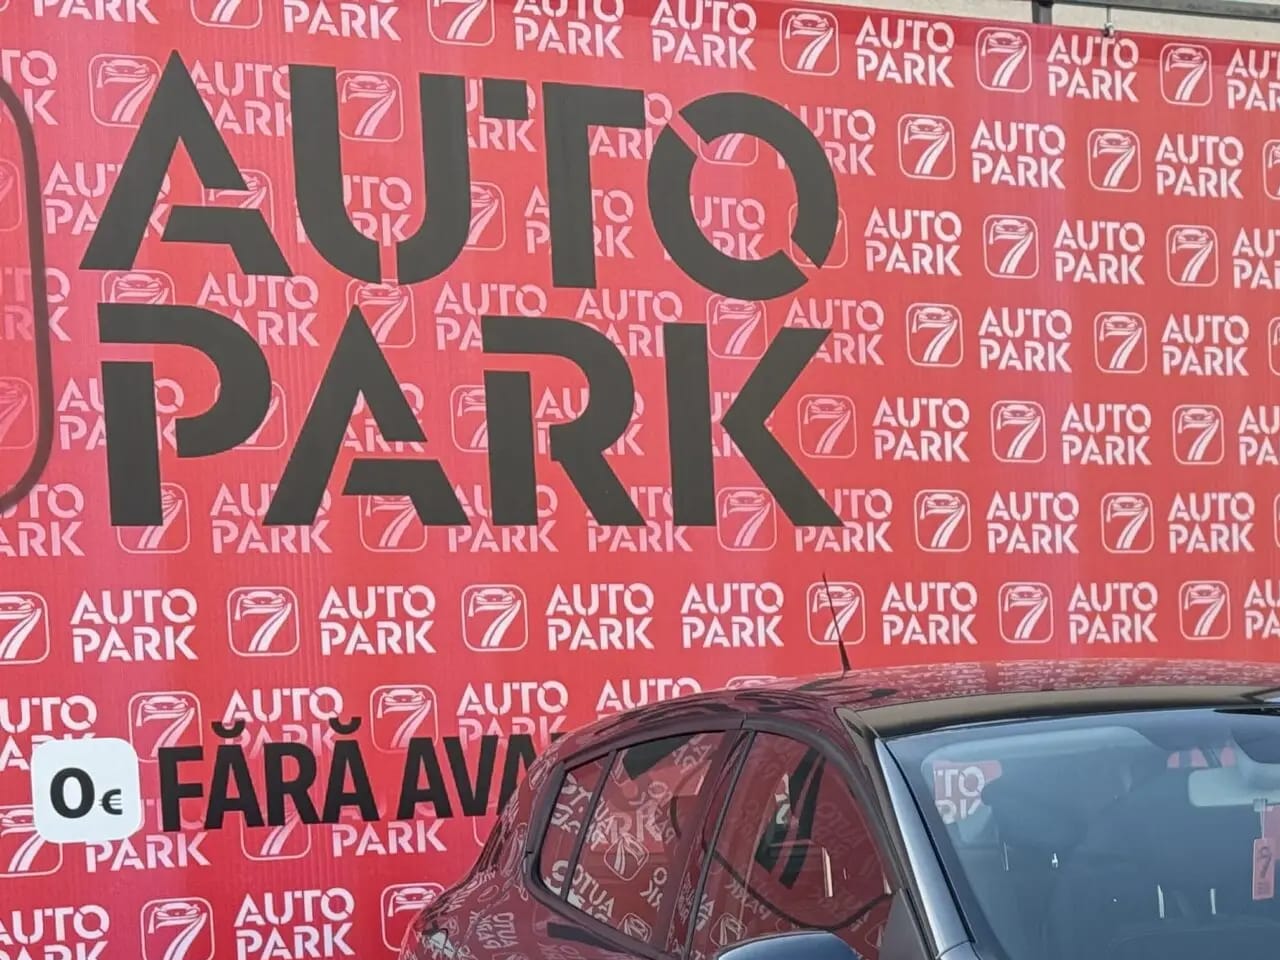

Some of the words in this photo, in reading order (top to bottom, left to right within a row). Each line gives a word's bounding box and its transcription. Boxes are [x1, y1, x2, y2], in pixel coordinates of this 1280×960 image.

[284, 2, 401, 40] PARK
[651, 0, 756, 35] AUTO
[857, 16, 954, 50] AUTO
[514, 20, 624, 59] PARK
[652, 31, 756, 71] PARK
[1047, 35, 1138, 69] AUTO
[857, 48, 954, 88] PARK
[1048, 65, 1138, 102] PARK
[971, 120, 1065, 156] AUTO
[1155, 134, 1244, 167] AUTO
[79, 49, 840, 300] AUTO
[972, 152, 1065, 189] PARK
[1157, 164, 1243, 198] PARK
[864, 207, 962, 242] AUTO
[1054, 220, 1145, 252] AUTO
[866, 240, 962, 276] PARK
[1055, 251, 1144, 284] PARK
[199, 272, 320, 309] AUTO
[435, 281, 548, 317] AUTO
[576, 288, 683, 323] AUTO
[784, 298, 885, 332] AUTO
[979, 307, 1072, 340] AUTO
[1161, 314, 1249, 345] AUTO
[811, 333, 885, 365] ARK
[980, 338, 1072, 372] PARK
[1163, 345, 1248, 376] PARK
[97, 304, 845, 527] PARK
[873, 397, 969, 429] AUTO
[1061, 403, 1151, 434] AUTO
[875, 429, 969, 462] PARK
[1062, 434, 1151, 465] PARK
[987, 491, 1079, 522] AUTO
[1168, 492, 1255, 521] AUTO
[212, 523, 332, 554] PARK
[796, 522, 893, 553] PARK
[988, 523, 1079, 554] PARK
[1169, 523, 1254, 553] PARK
[70, 589, 197, 626] AUTO
[319, 585, 435, 619] AUTO
[546, 583, 654, 616] AUTO
[681, 582, 784, 614] AUTO
[881, 582, 977, 612] AUTO
[1068, 582, 1158, 612] AUTO
[72, 626, 198, 663] PARK
[321, 620, 436, 655] PARK
[548, 617, 654, 651] PARK
[682, 616, 784, 648] PARK
[883, 614, 977, 644] PARK
[1069, 613, 1157, 644] PARK
[0, 695, 97, 733] UTO
[225, 687, 343, 722] AUTO
[457, 681, 568, 716] AUTO
[158, 716, 379, 832] FĂRĂ
[397, 731, 567, 821] AVA
[86, 833, 210, 872] PARK
[332, 818, 447, 857] PARK
[234, 888, 354, 927] AUTO
